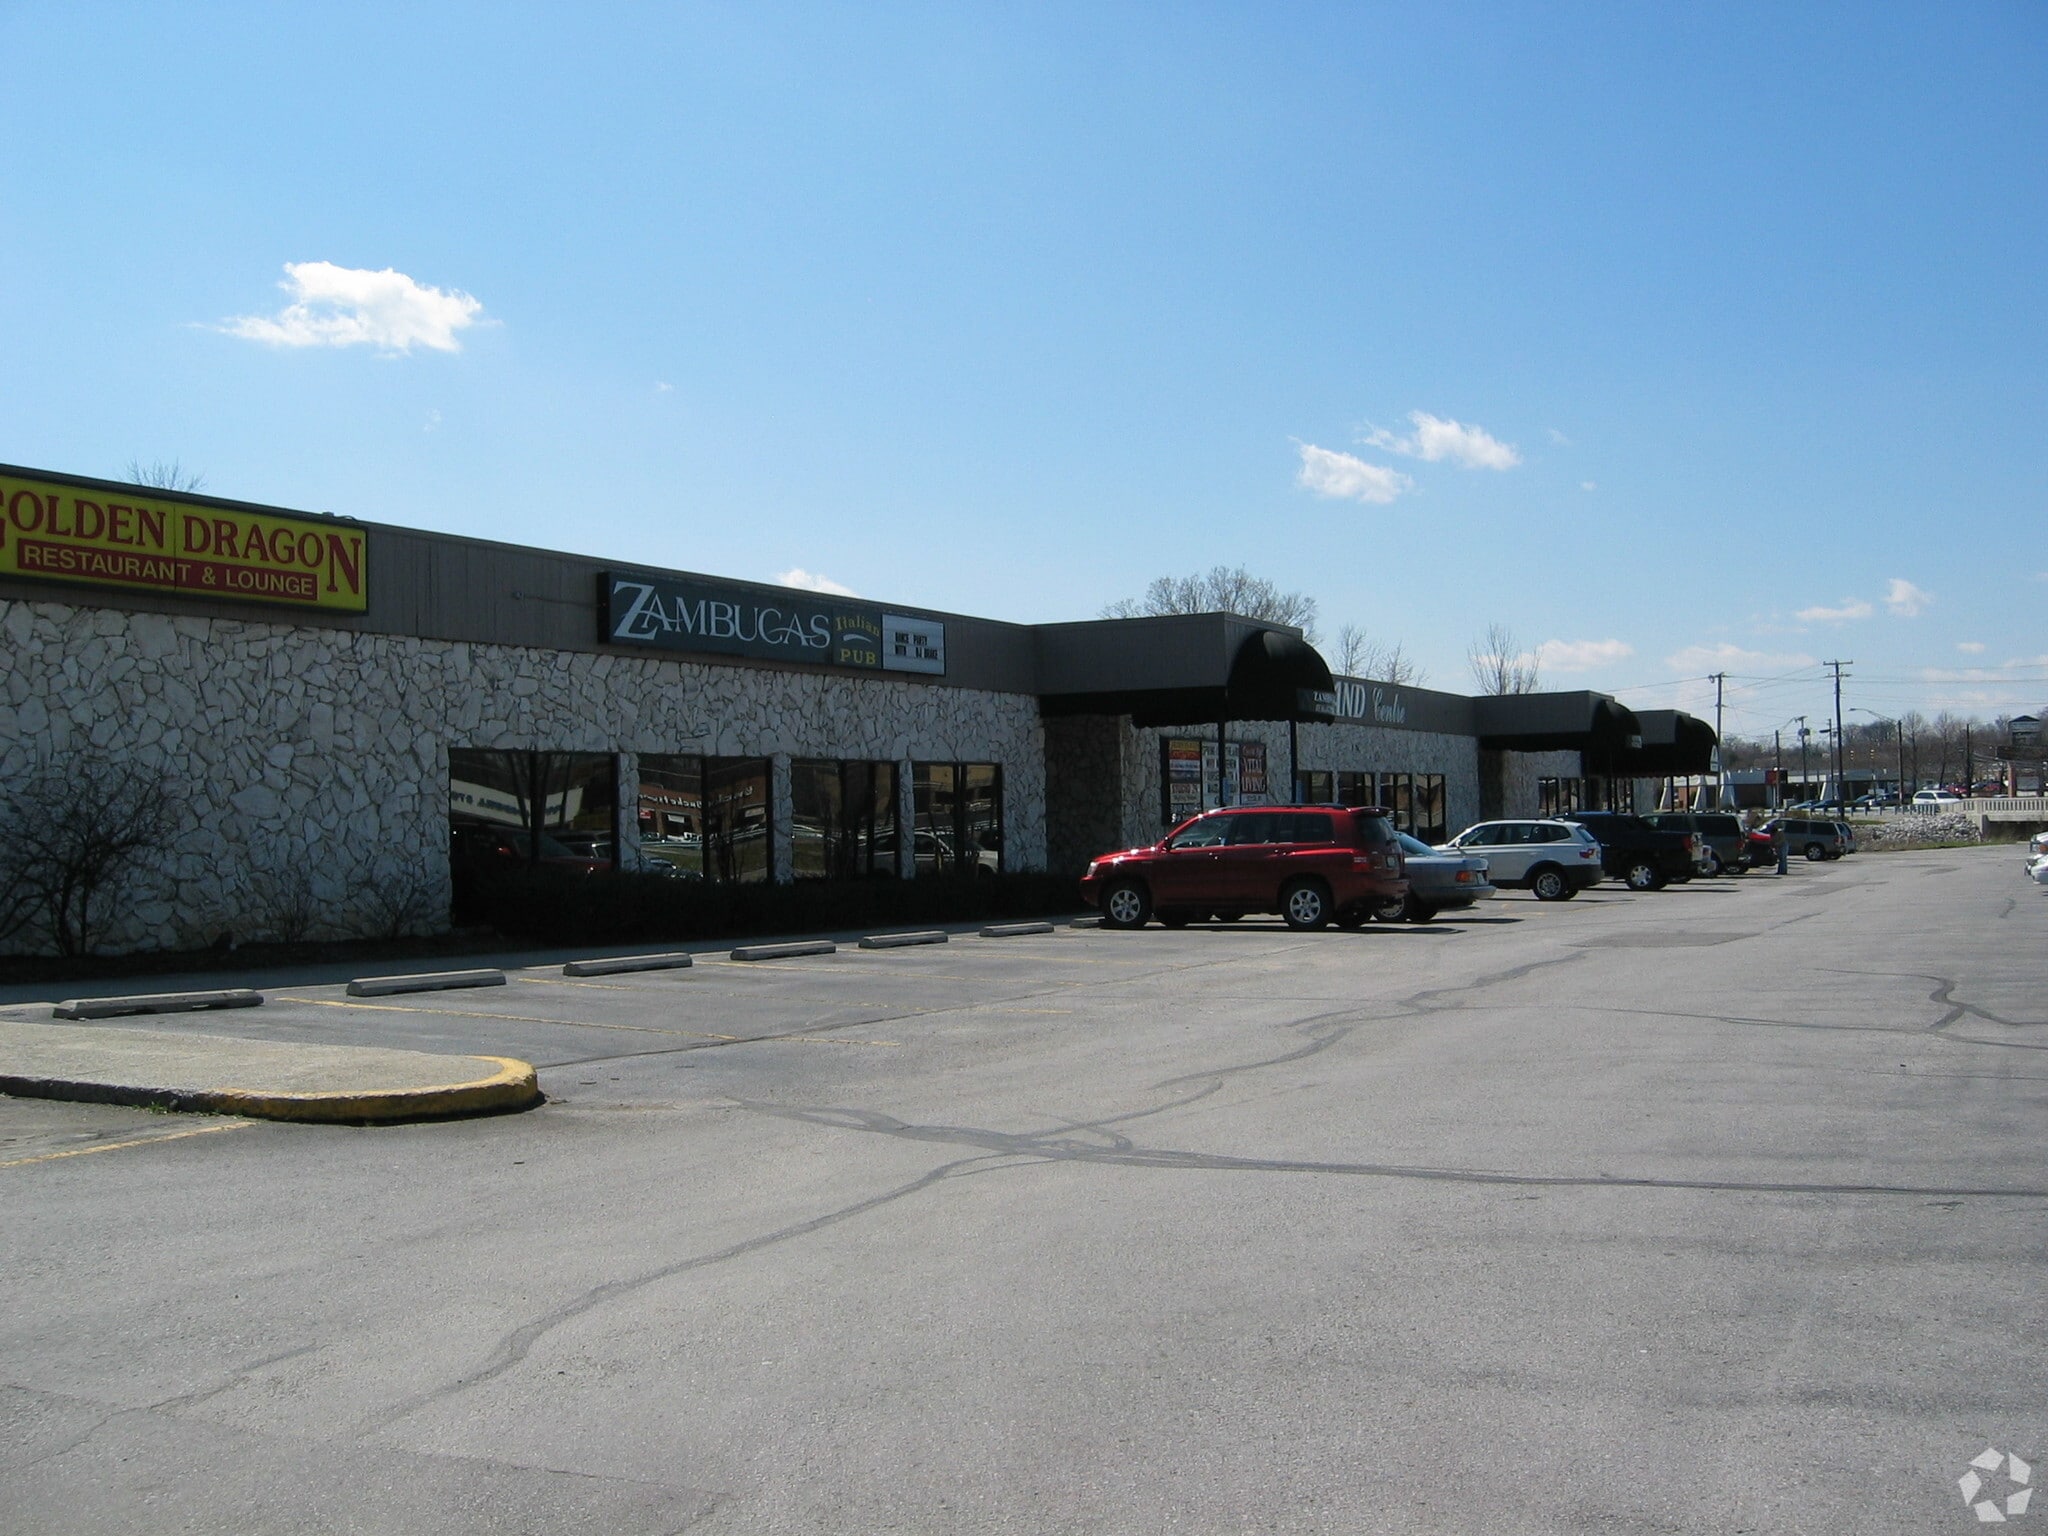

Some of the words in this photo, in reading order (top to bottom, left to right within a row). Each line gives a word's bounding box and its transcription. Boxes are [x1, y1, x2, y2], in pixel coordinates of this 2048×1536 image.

[0, 489, 166, 549] OLDEN
[183, 515, 362, 594] DRAGON
[24, 545, 191, 582] RESTAURANT
[202, 566, 216, 585] &
[226, 569, 313, 596] LOUNGE
[613, 581, 830, 648] ZAMBUCAS
[835, 614, 880, 638] Italian
[839, 648, 876, 665] PUB
